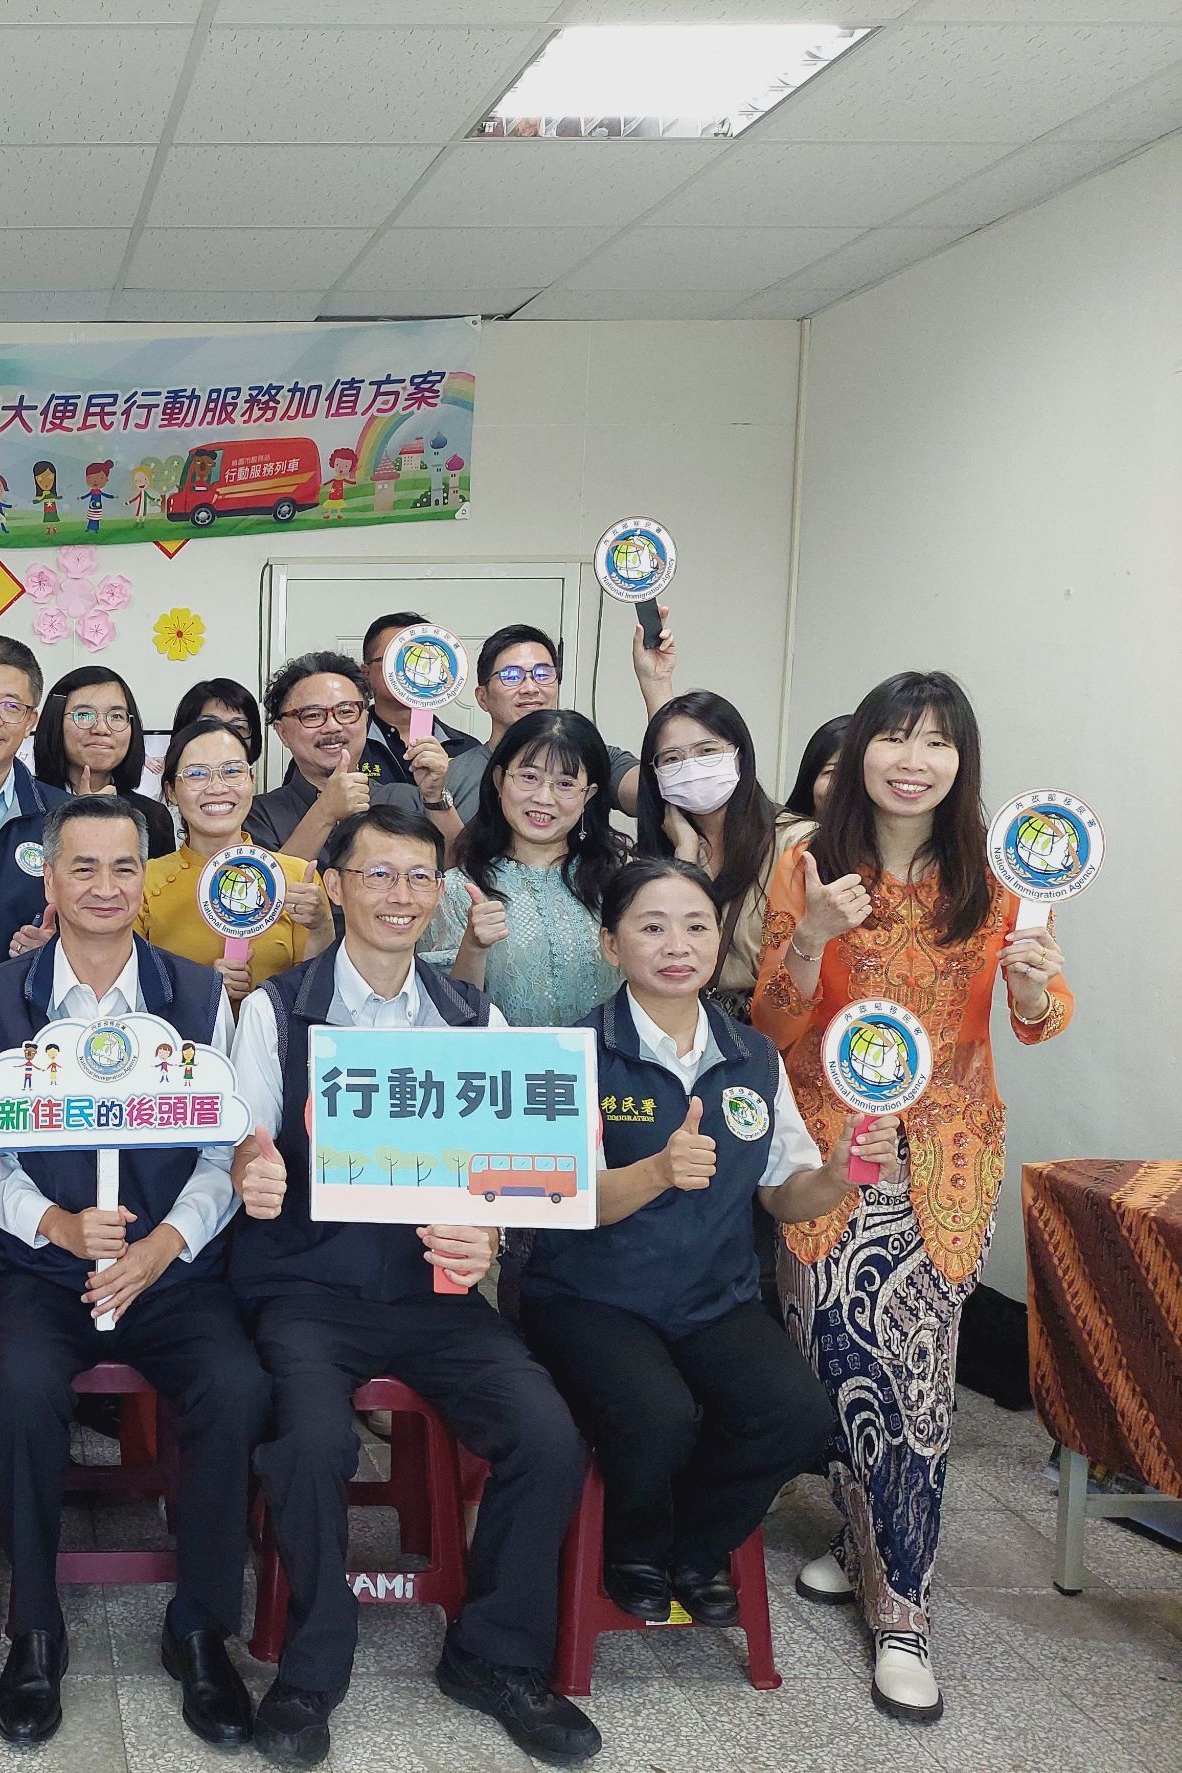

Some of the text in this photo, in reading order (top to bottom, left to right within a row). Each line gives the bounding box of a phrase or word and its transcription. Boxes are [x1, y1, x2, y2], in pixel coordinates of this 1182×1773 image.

[225, 458, 300, 483] 行動服務列車
[387, 671, 406, 698] National
[446, 675, 465, 700] Agency
[993, 847, 1096, 900] National Immigration Agency
[202, 898, 283, 938] National Immigration Agency
[321, 1066, 581, 1122] 行動列車
[828, 1060, 927, 1113] National Immigration Agency
[601, 1095, 658, 1116] 移民署
[345, 1573, 415, 1599] AMi
